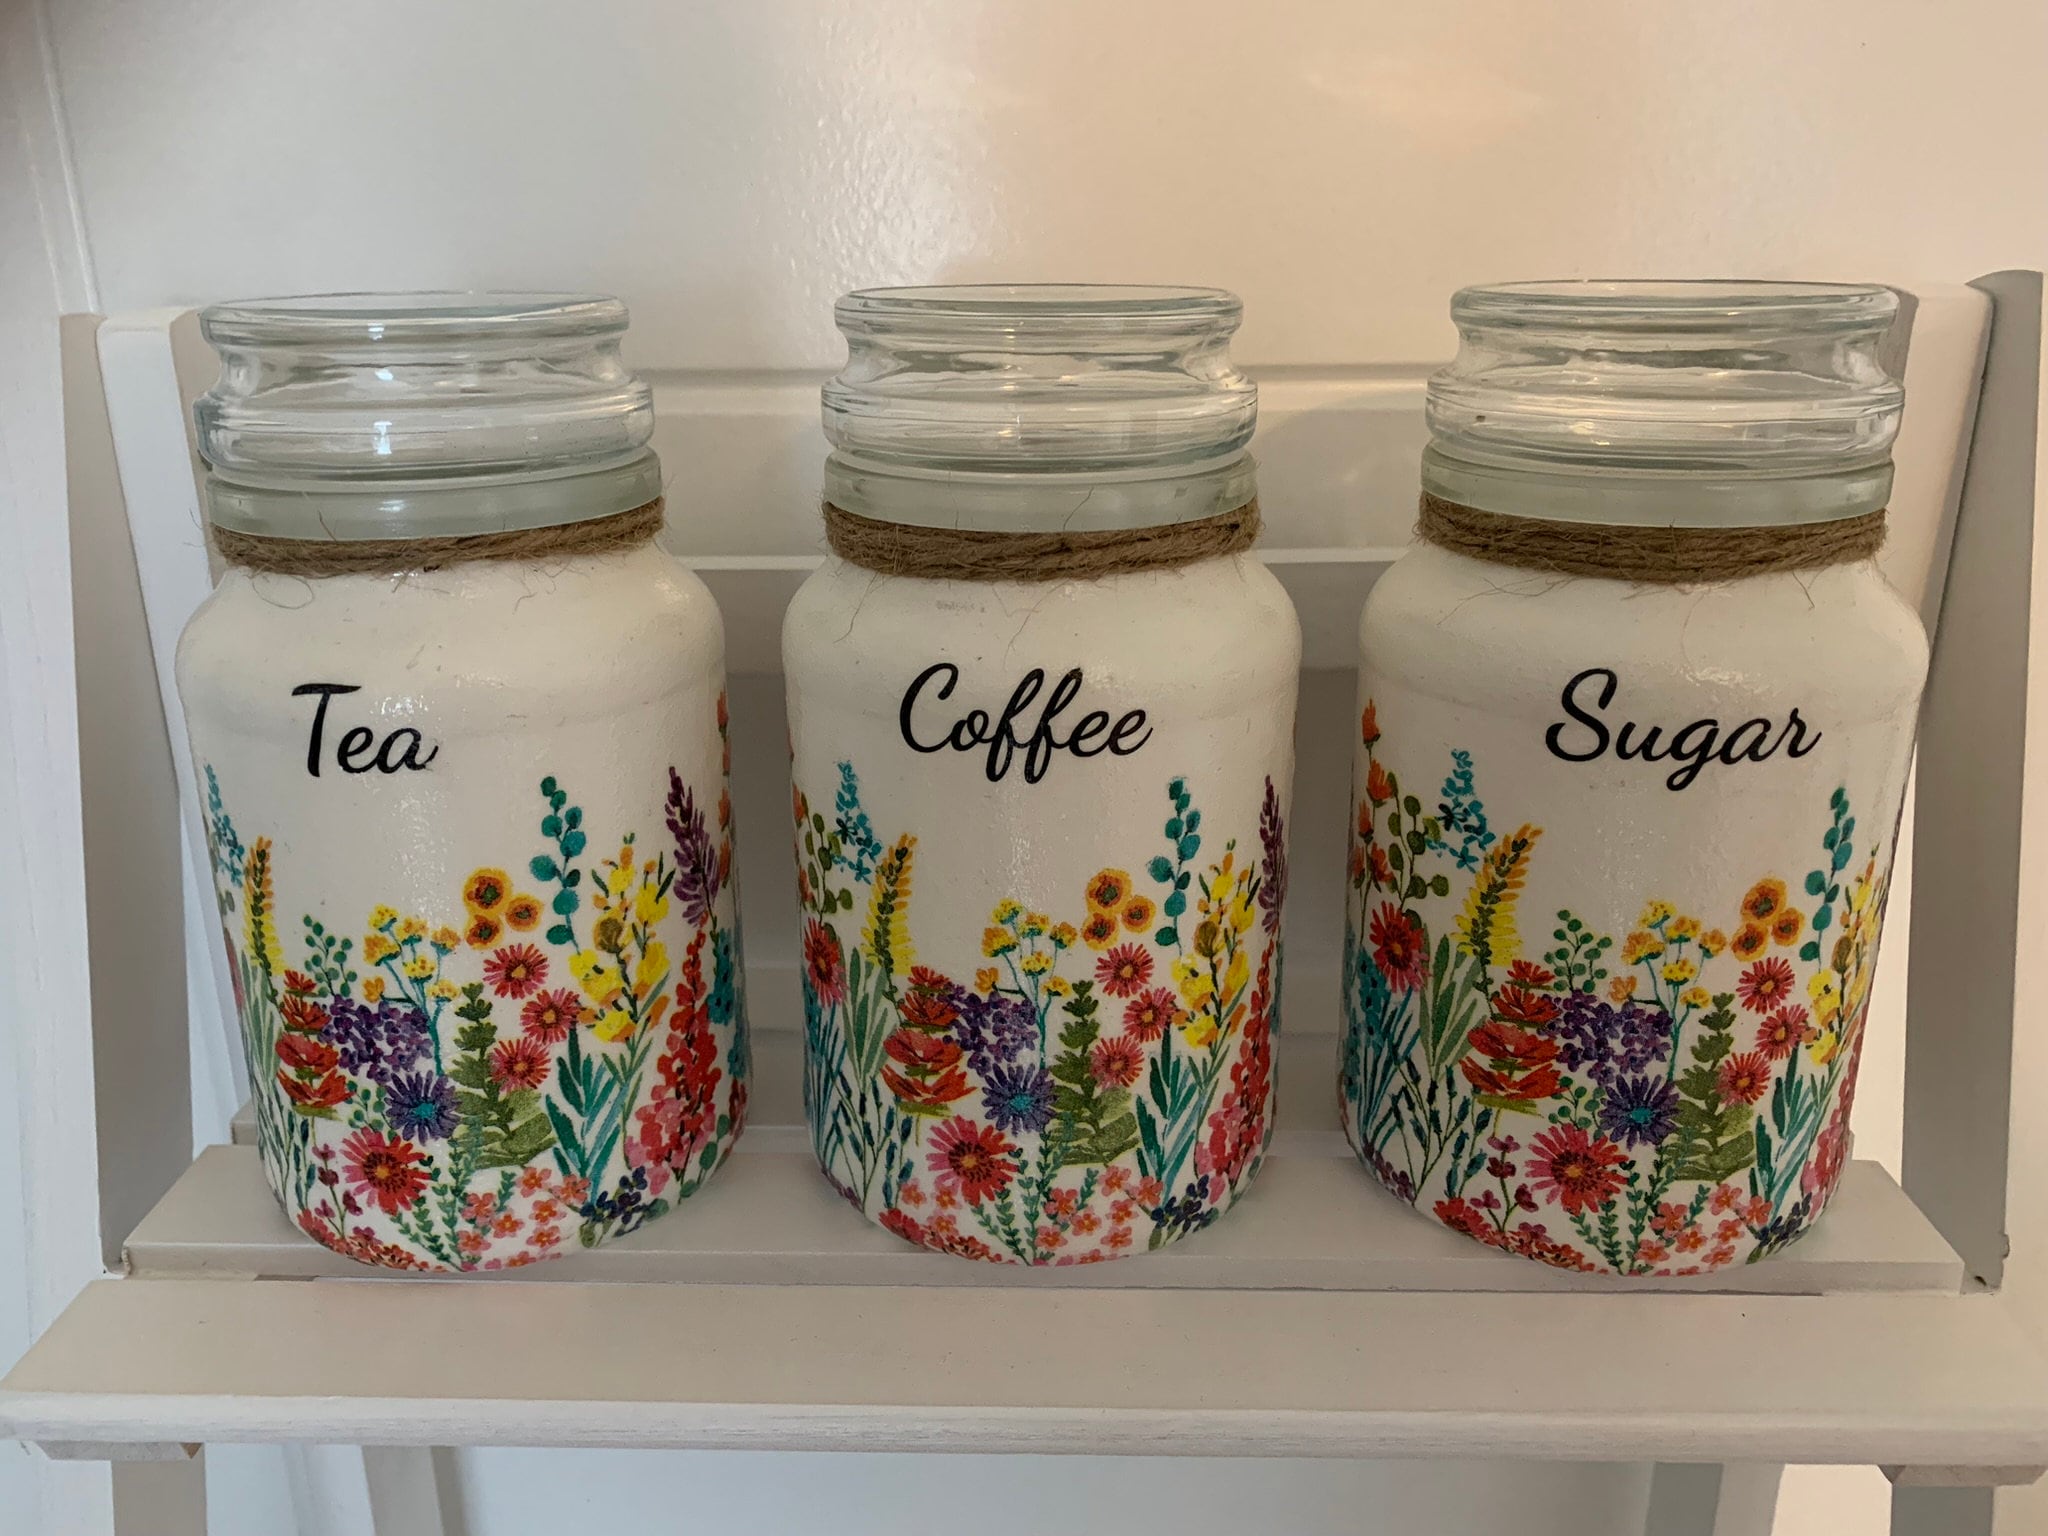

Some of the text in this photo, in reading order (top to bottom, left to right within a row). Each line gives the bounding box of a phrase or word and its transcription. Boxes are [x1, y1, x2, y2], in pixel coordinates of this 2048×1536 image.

[291, 683, 439, 777] Tea
[900, 662, 1154, 784] Coffee
[1545, 668, 1822, 791] Sugar
